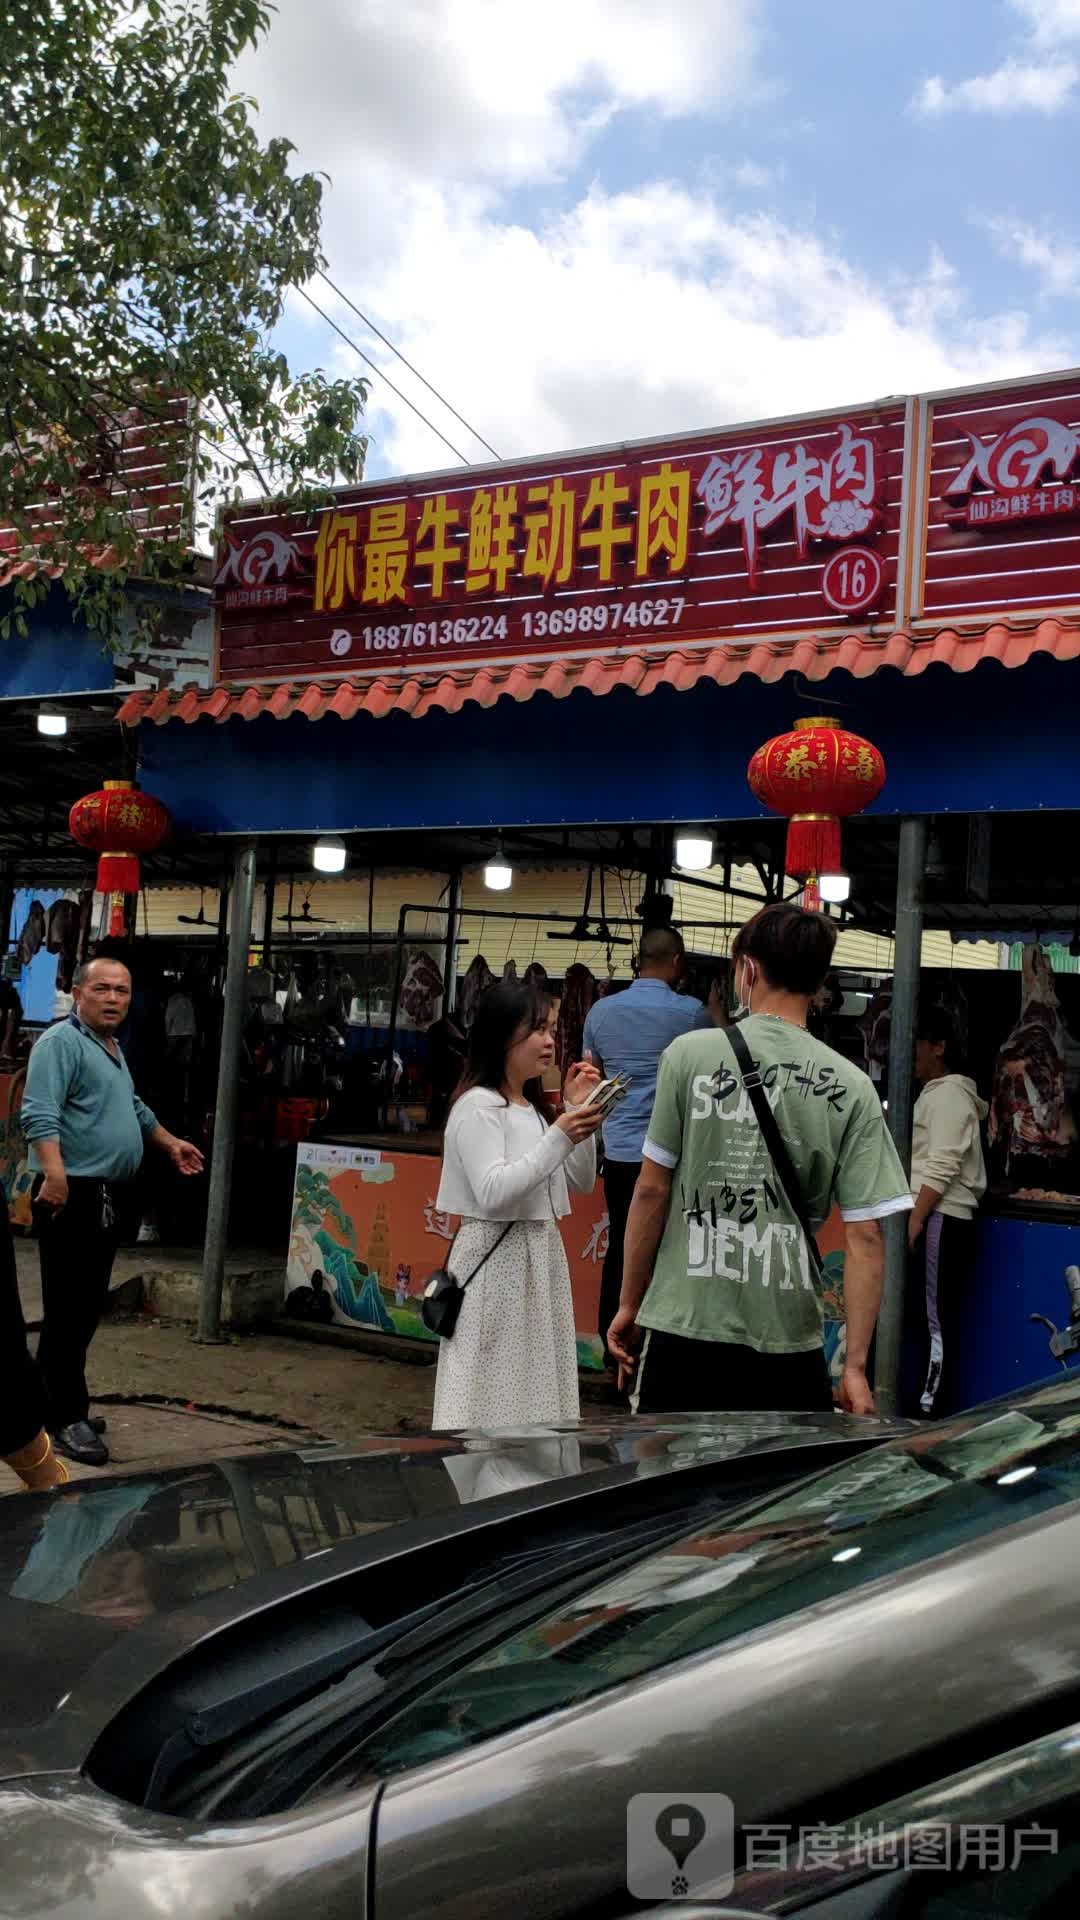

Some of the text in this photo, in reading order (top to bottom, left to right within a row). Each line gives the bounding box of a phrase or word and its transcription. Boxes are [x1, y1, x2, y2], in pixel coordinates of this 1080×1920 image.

[697, 424, 875, 574] 鲜牛肉
[313, 463, 692, 611] 你最牛鲜动牛肉
[838, 559, 867, 599] 16
[362, 597, 686, 651] 18876136224 13698974627
[712, 1061, 848, 1112] BOTHER
